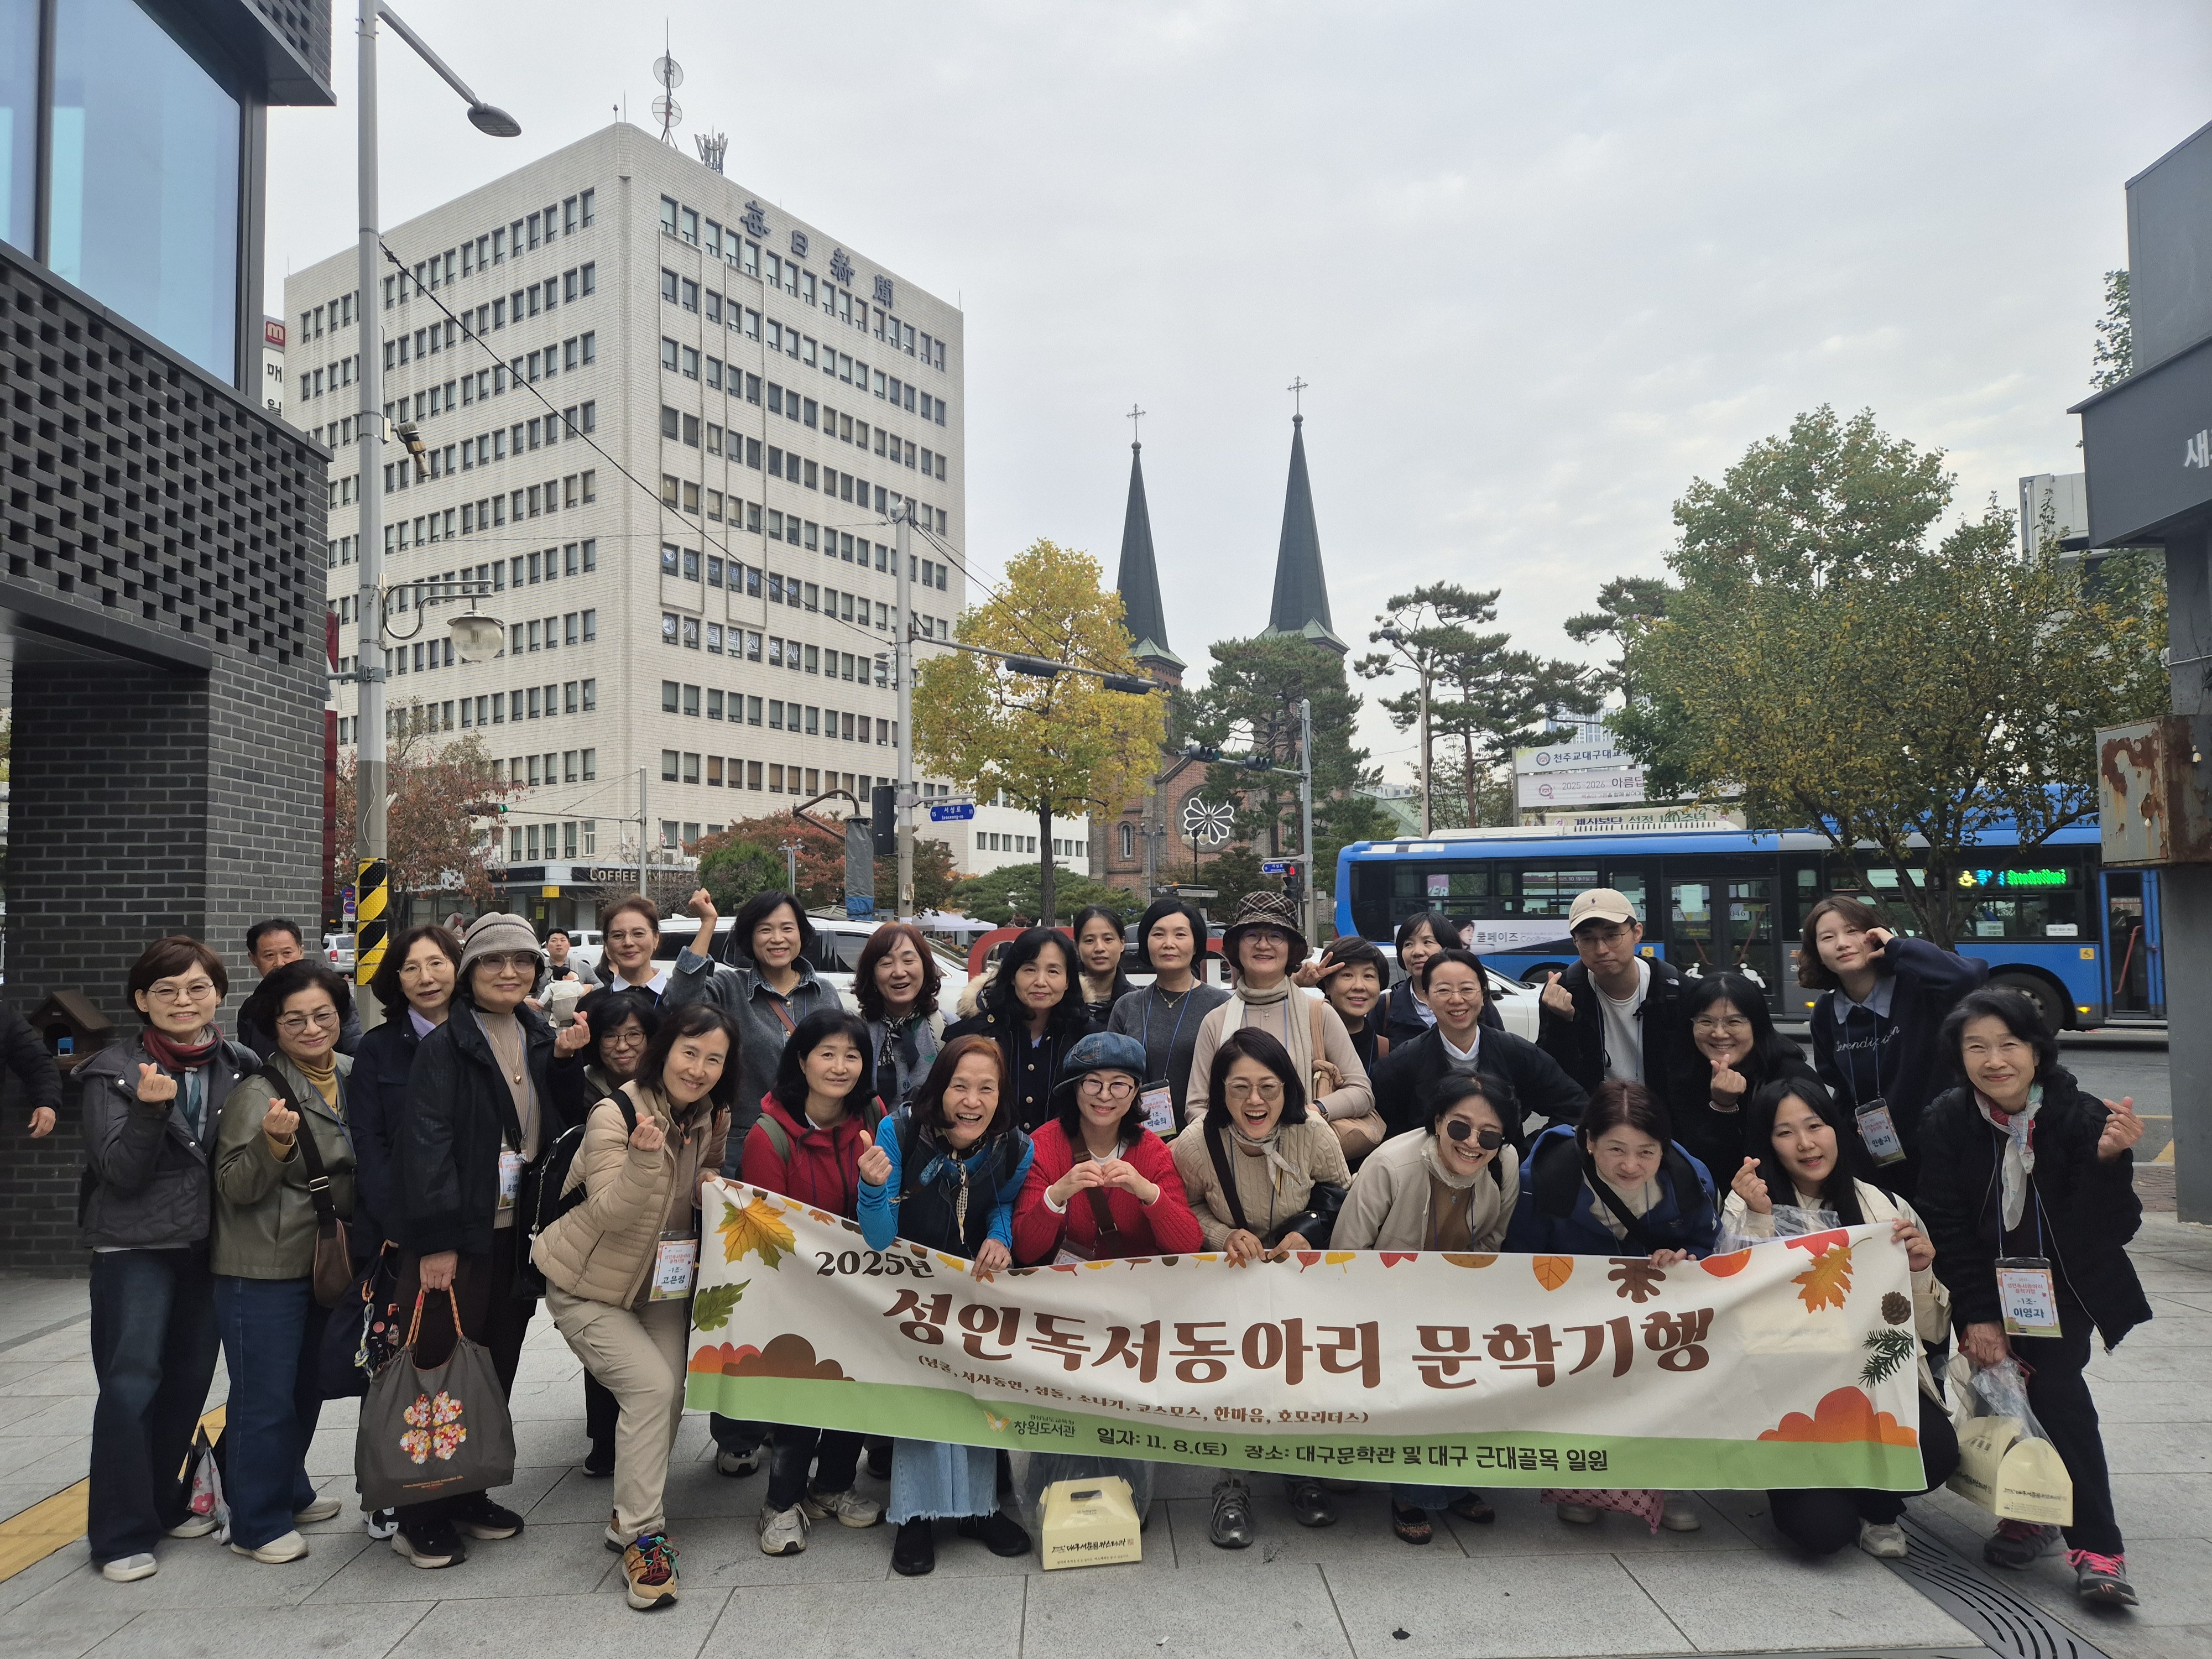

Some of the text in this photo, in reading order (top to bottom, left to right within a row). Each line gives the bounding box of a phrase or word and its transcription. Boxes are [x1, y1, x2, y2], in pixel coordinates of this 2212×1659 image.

[2184, 429, 2212, 468] 새
[684, 621, 798, 661] 가톨릭신문사
[1562, 780, 1605, 790] 2025~2026
[589, 867, 637, 882] COFFEE
[1477, 932, 1519, 942] 쿨페이즈
[815, 1250, 935, 1278] 2025년
[661, 1275, 685, 1284] 고은정
[2013, 1307, 2045, 1318] 이영자
[883, 1288, 1714, 1389] 성인독서동아리 문학기행
[1078, 1395, 1130, 1411] 소나기,
[1136, 1404, 1208, 1422] 코스모스,
[1214, 1406, 1271, 1425] 한마음,
[1277, 1410, 1369, 1424] 호모리더스)
[1029, 1415, 1074, 1425] 경상남도교육청
[1014, 1421, 1076, 1438] 창원도서관
[1097, 1427, 1608, 1472] 일자: 11. 8.(토) 장소: 대구문학관 및 대구 근대골목 일원
